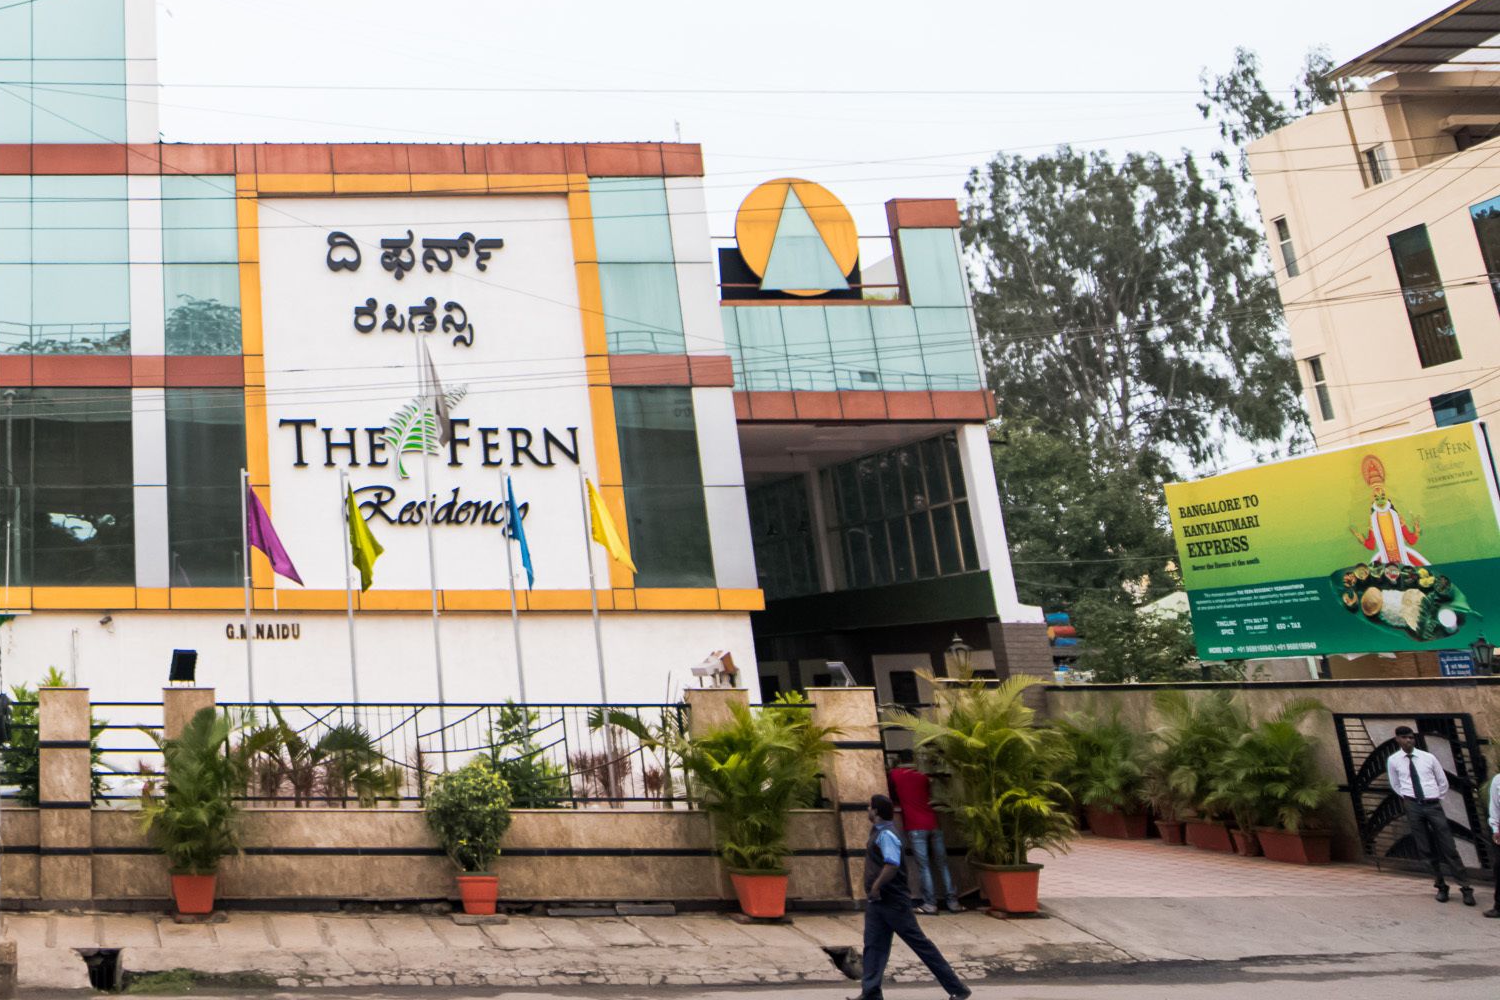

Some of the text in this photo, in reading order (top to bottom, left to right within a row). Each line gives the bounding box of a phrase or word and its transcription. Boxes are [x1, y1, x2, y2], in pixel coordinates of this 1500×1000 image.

[326, 231, 362, 272] ದಿ
[279, 418, 580, 468] THE FERN
[1445, 441, 1472, 456] FERN
[1178, 494, 1260, 519] BANGALORE TO
[1183, 515, 1261, 538] KANYAKUMARI
[1186, 535, 1251, 559] EXPRESS
